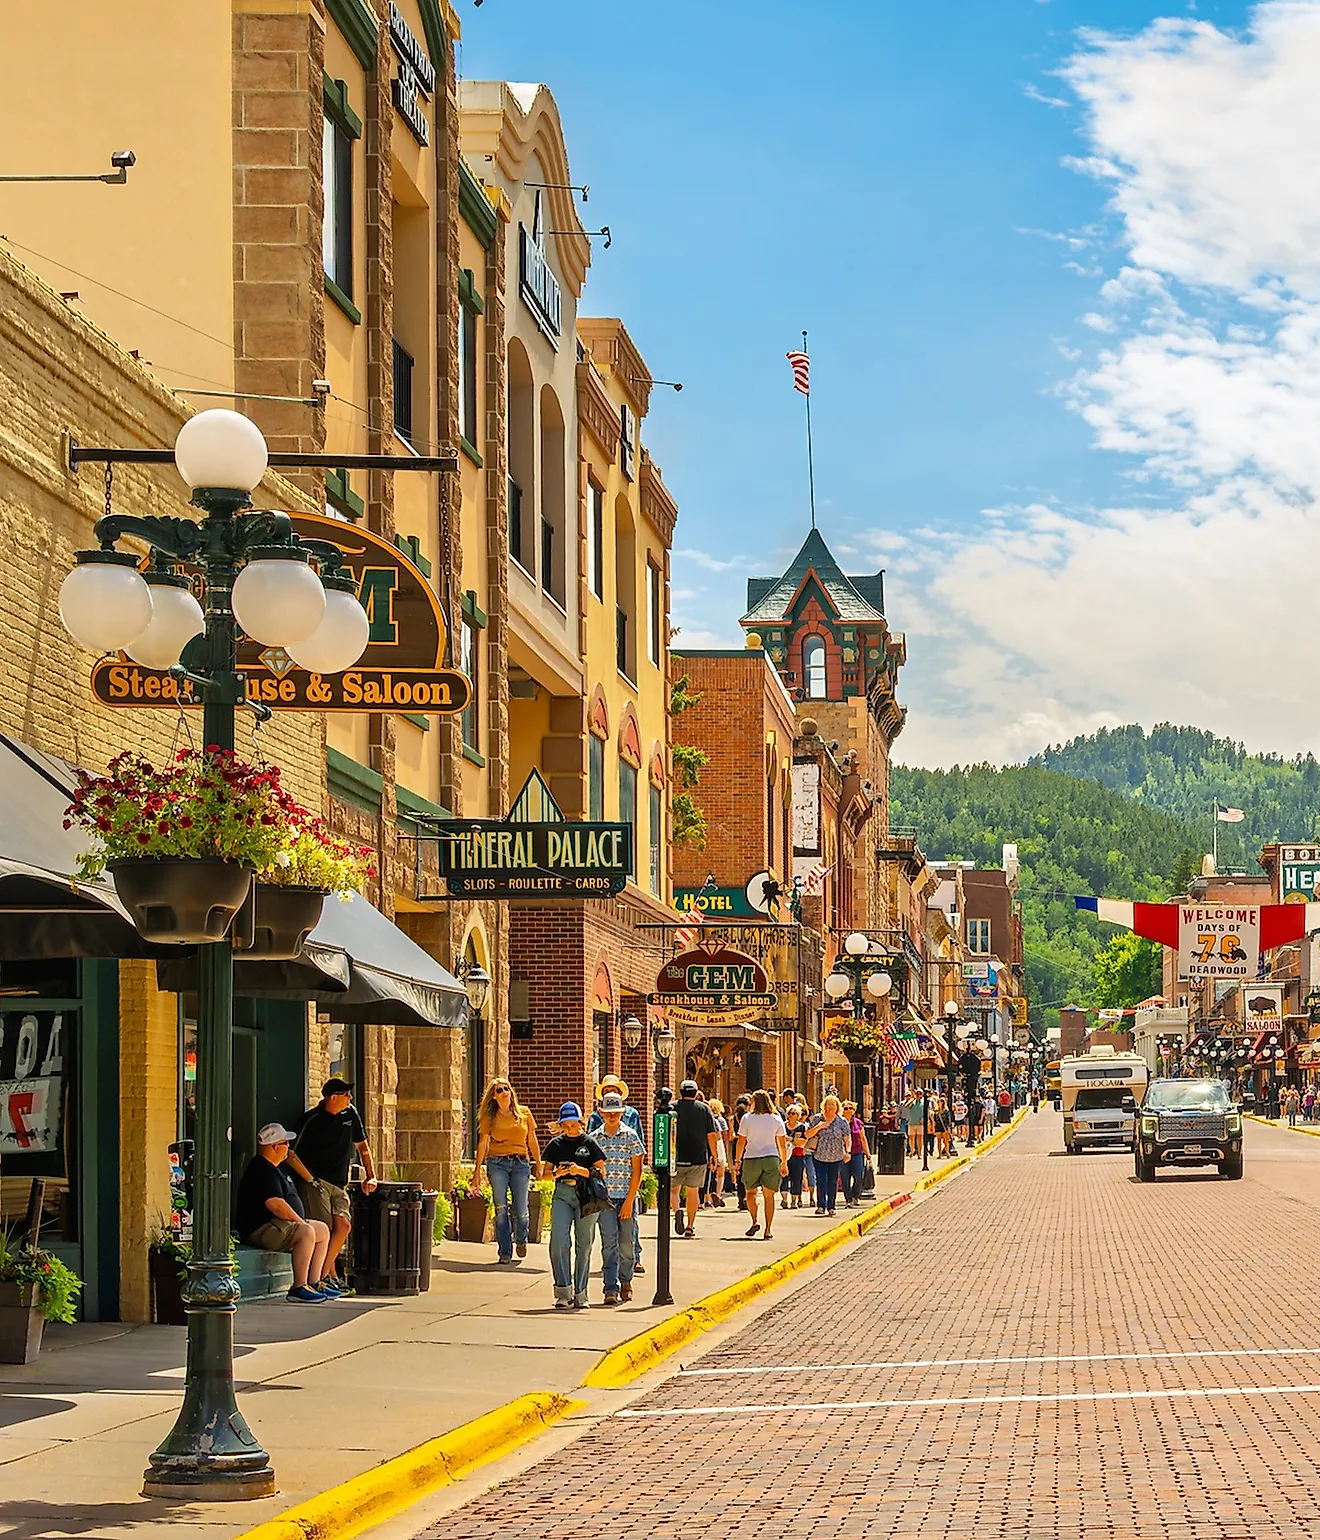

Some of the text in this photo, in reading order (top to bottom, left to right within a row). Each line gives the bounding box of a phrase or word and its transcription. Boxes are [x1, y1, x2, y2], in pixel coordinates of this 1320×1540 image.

[305, 673, 332, 702] &
[342, 673, 453, 705] Saloon
[450, 830, 623, 869] MINERAL PALACE
[463, 878, 495, 890] SLOTS
[509, 878, 562, 889] ROULETTE
[575, 877, 610, 889] CARDS
[683, 893, 732, 911] HOTEL
[1183, 909, 1257, 926] WELCOME
[1229, 924, 1241, 932] OF
[1197, 934, 1240, 963] 76
[1190, 965, 1246, 974] DEADWOOD
[667, 964, 755, 991] The GEM
[652, 994, 771, 1005] Steakhouse & Saloon
[668, 1009, 756, 1023] Breakfast Lunch Dinner
[1247, 1021, 1280, 1030] SALOON
